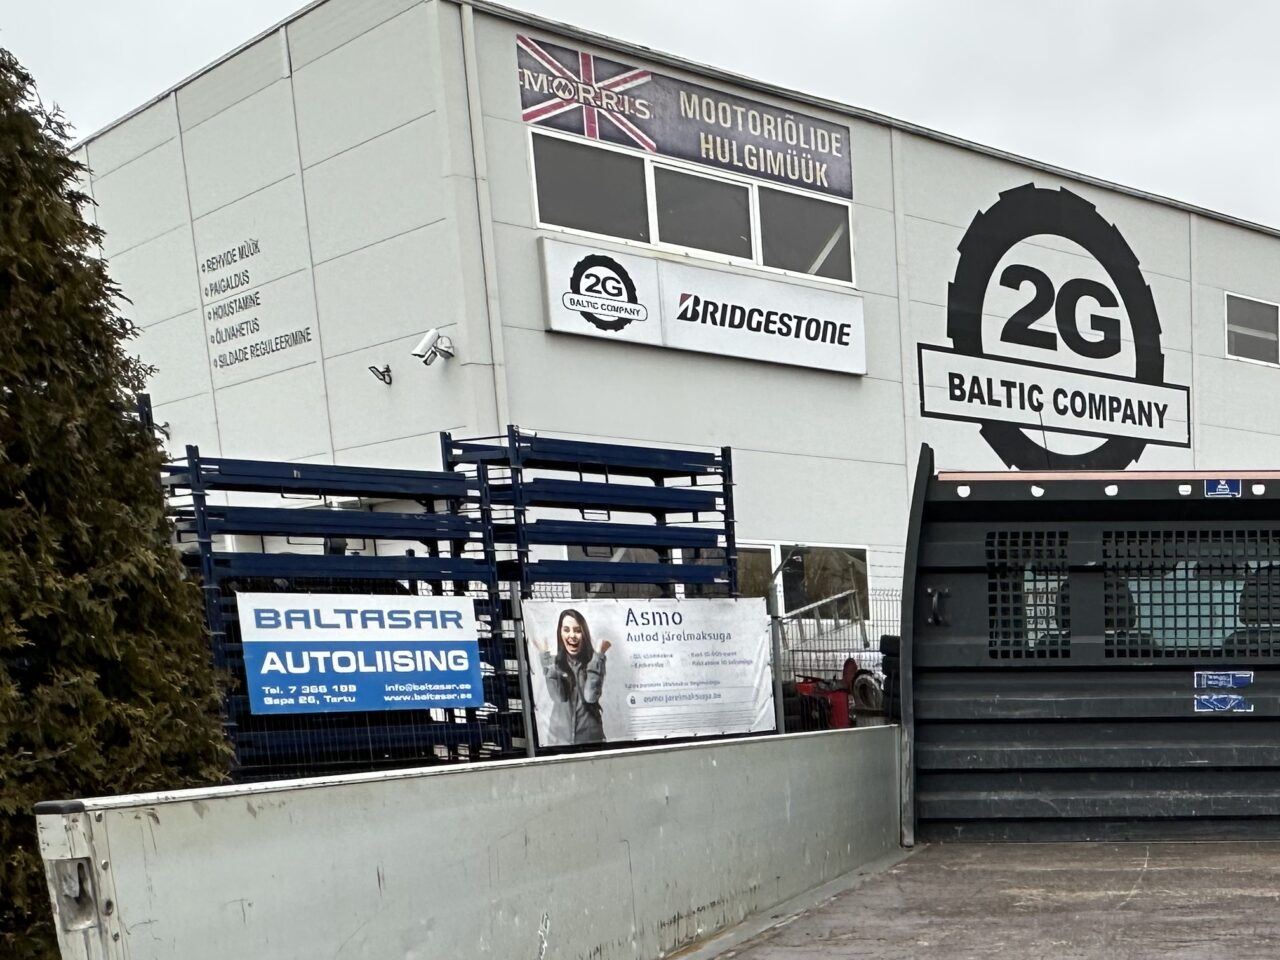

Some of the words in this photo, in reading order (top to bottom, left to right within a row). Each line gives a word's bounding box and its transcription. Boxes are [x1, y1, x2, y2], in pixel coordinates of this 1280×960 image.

[679, 90, 842, 157] MOOTORIÕLIDE
[700, 132, 829, 188] HULGIMÜÜK
[206, 248, 238, 272] REHVIDE
[238, 239, 260, 260] MÜÜK
[210, 270, 250, 297] PAIGALDUS
[584, 272, 623, 297] 2G
[212, 291, 261, 320] HOIUSTAMINE
[569, 297, 599, 311] BALTIC
[600, 302, 641, 318] COMPANY
[677, 293, 851, 346] BRIDGESTONE
[999, 264, 1121, 359] 2G
[219, 347, 249, 369] SILDADE
[250, 327, 312, 359] REGULEERIMINE
[948, 372, 1044, 413] BALTIC
[1052, 388, 1168, 429] COMPANY
[253, 608, 463, 630] BALTASAR
[625, 608, 683, 627] Asmo
[626, 632, 659, 642] Autod
[662, 631, 732, 644] järelmaksuga
[261, 649, 469, 675] AUTOLIISING
[326, 694, 356, 703] Tartu
